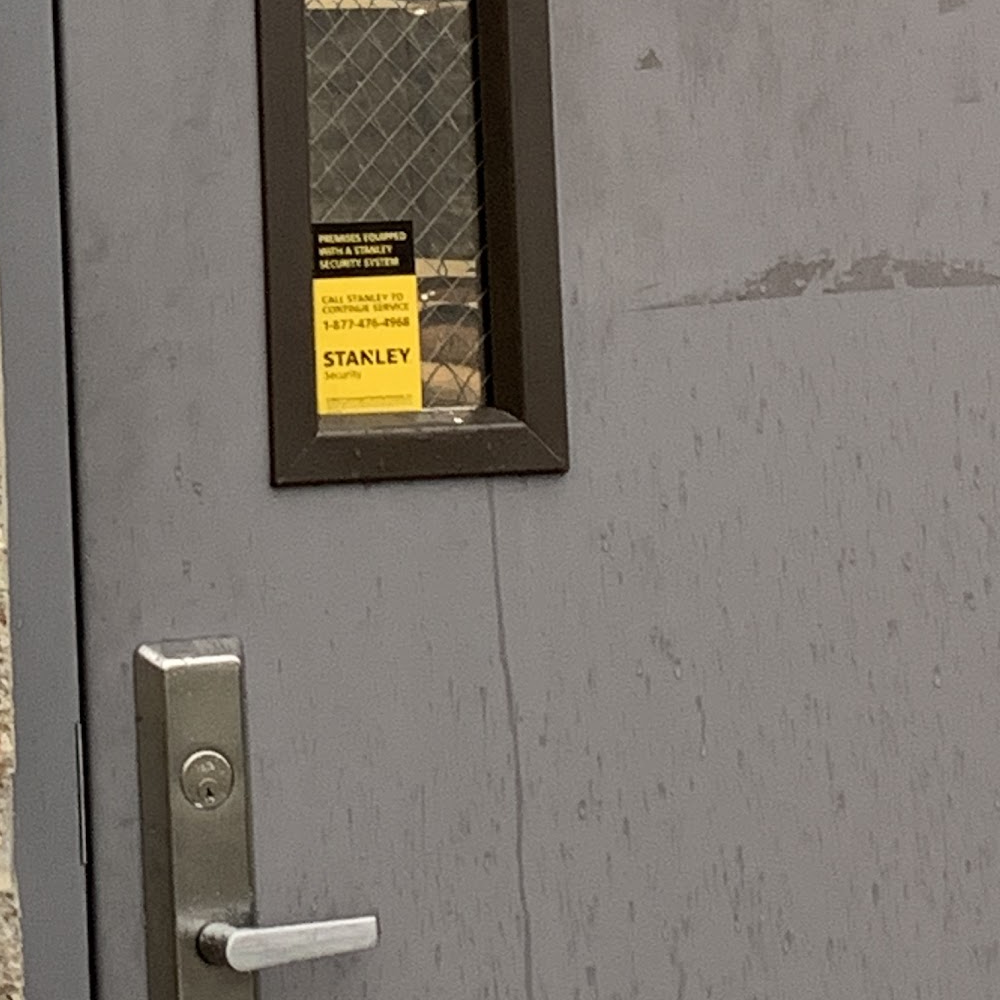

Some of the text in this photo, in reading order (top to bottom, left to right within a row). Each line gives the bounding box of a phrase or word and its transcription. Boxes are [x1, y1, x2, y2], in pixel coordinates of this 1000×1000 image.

[345, 246, 352, 255] A
[354, 245, 393, 255] STANLEY
[320, 257, 399, 270] SECURITY SYSTEM
[322, 293, 404, 304] CALL STANLEY TO
[322, 303, 409, 314] CONTINUE SERVICE
[323, 348, 410, 367] STANLEY
